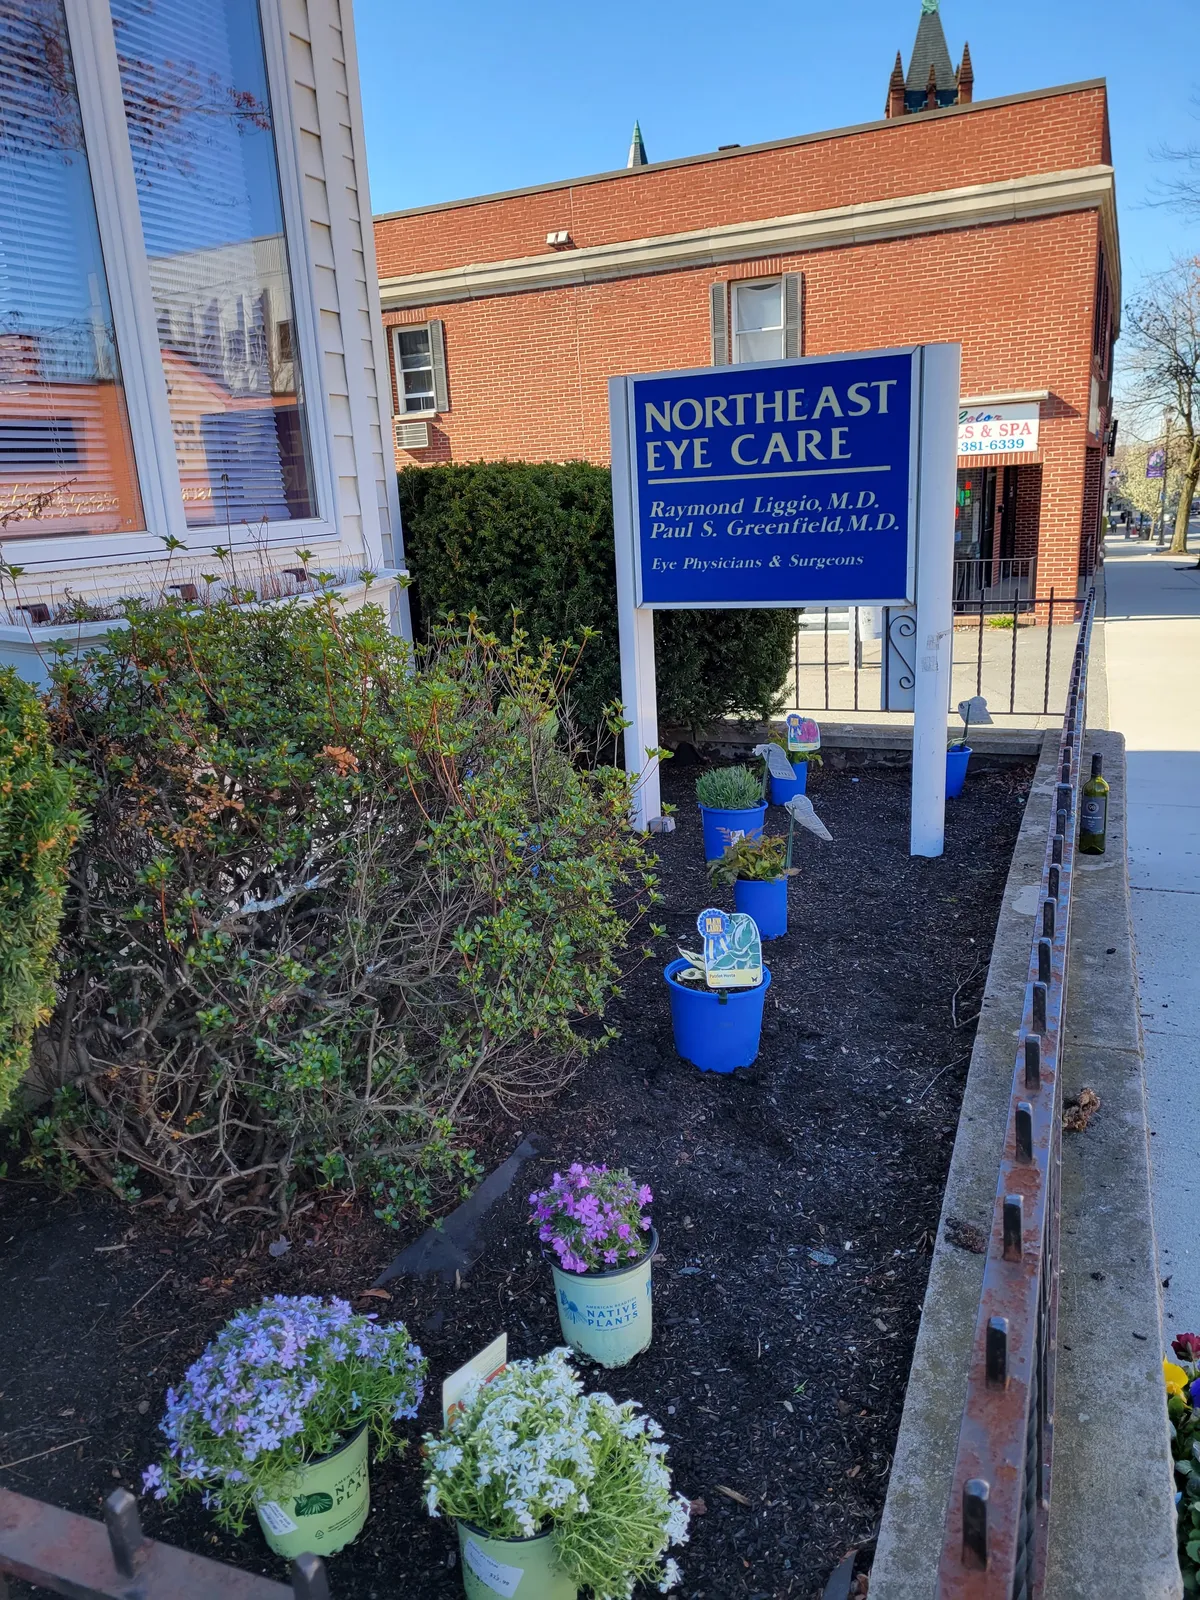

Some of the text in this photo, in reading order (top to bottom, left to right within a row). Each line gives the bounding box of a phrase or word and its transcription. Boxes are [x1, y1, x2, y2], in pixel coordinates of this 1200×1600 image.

[645, 380, 897, 433] NORTHEAST
[959, 410, 1003, 425] Color
[981, 425, 992, 438] &
[999, 422, 1032, 437] SPA
[646, 426, 852, 472] EYE CARE
[649, 490, 880, 521] Raymond Liggio, M.D.
[650, 512, 900, 540] Paul S. Greenfield, M.D.
[652, 553, 864, 573] Eye Physicians & Surgeons
[587, 1301, 637, 1318] NATIVE
[588, 1310, 638, 1327] PLANTS
